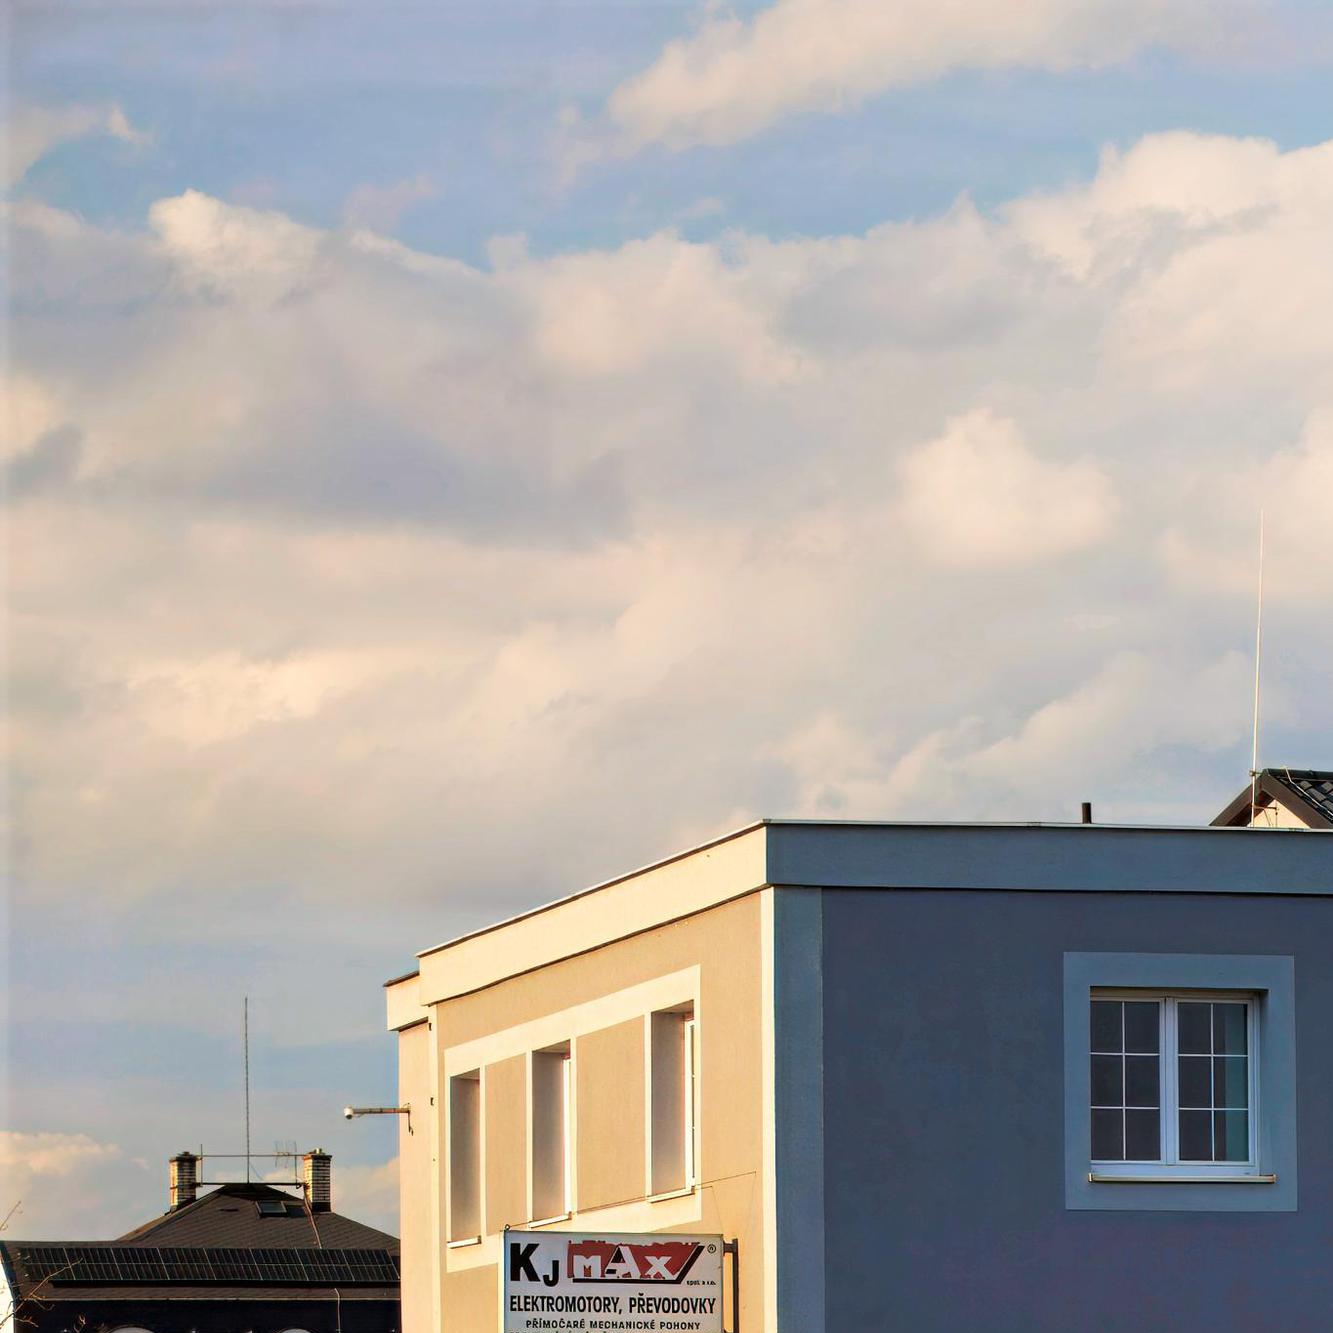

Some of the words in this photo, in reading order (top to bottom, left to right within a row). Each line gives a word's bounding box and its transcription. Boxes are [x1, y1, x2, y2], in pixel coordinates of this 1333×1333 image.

[510, 1243, 560, 1287] KJ
[510, 1295, 623, 1315] ELEKTROMOTORY,
[629, 1292, 717, 1315] PŘEVODOVKY
[526, 1317, 586, 1330] PŘÍMOČARÉ
[590, 1319, 656, 1330] MECHANICKÉ
[660, 1321, 701, 1331] POHONY
